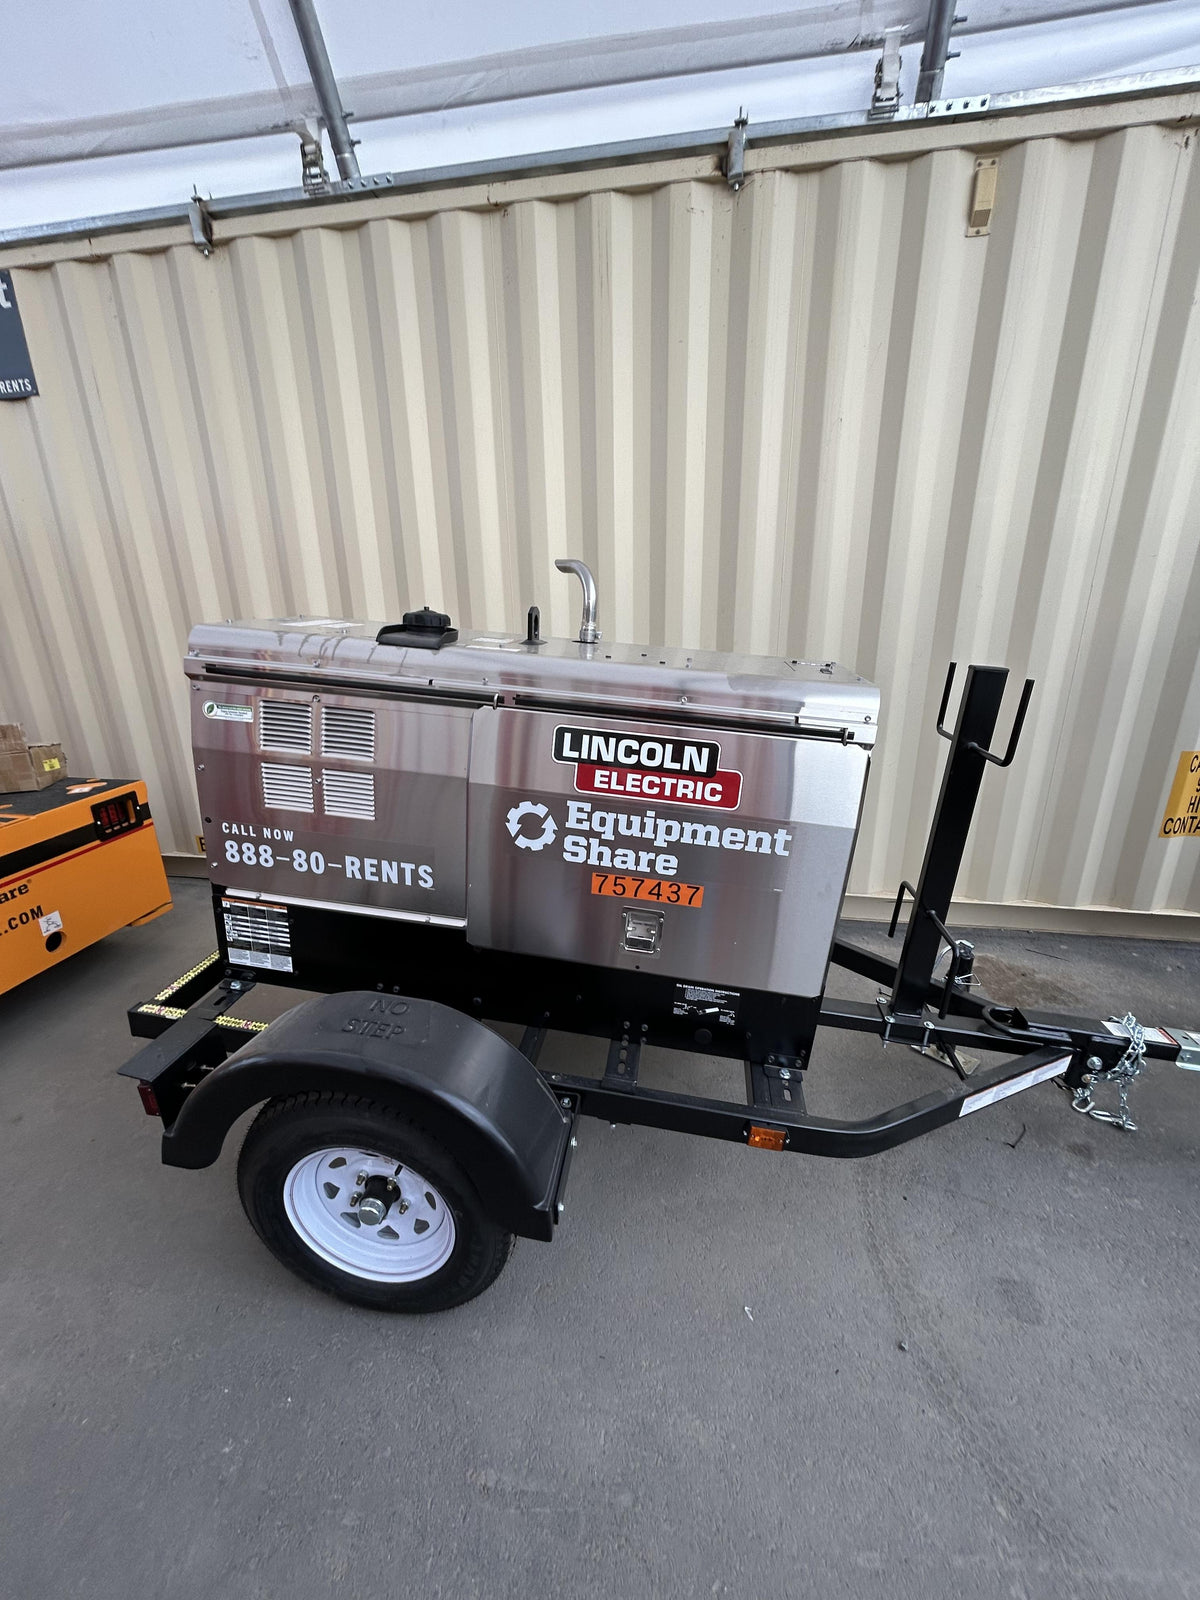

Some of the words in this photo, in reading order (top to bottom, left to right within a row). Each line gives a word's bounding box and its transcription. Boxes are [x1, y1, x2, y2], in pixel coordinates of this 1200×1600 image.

[0, 378, 32, 394] RENTS
[562, 732, 710, 773] LINCOLN
[593, 769, 723, 802] ELECTRIC
[222, 822, 257, 837] CALL
[263, 827, 295, 843] NOW
[565, 800, 792, 857] Equipment
[224, 840, 434, 889] 888-80-RENTS
[562, 834, 679, 876] Share
[595, 873, 701, 906] 757437
[0, 905, 43, 936] .COM
[369, 999, 410, 1015] NO
[342, 1018, 407, 1039] STEP
